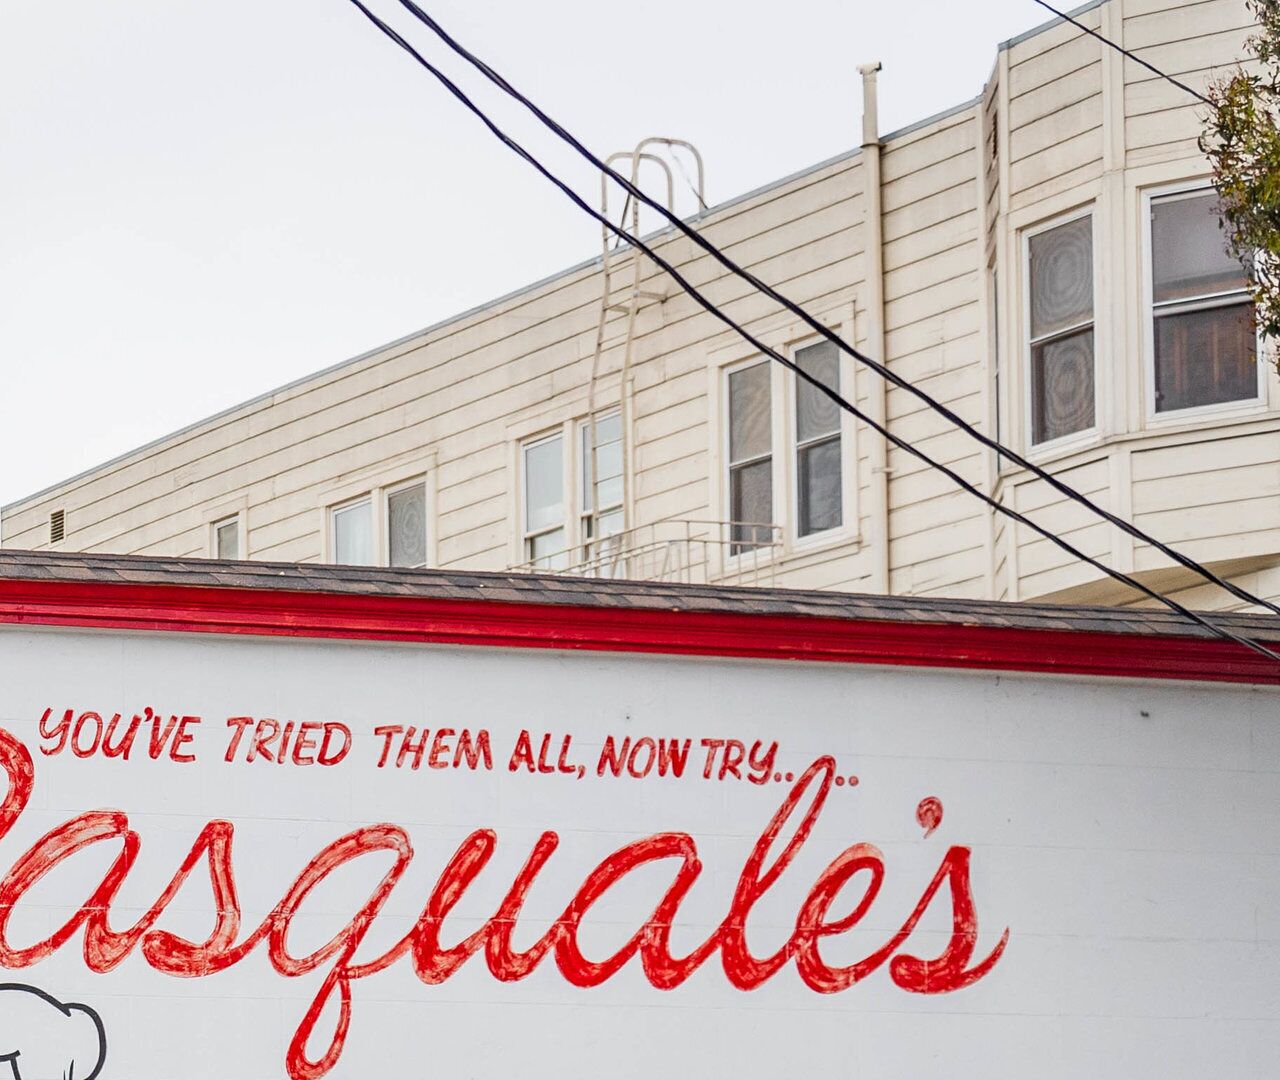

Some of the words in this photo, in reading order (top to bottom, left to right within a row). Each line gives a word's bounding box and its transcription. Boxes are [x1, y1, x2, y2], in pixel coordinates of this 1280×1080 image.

[38, 705, 201, 764] YOU'VE
[226, 716, 353, 767] TRIED
[374, 724, 493, 772] THEM
[509, 729, 586, 780] ALL,
[596, 735, 691, 780] NOW
